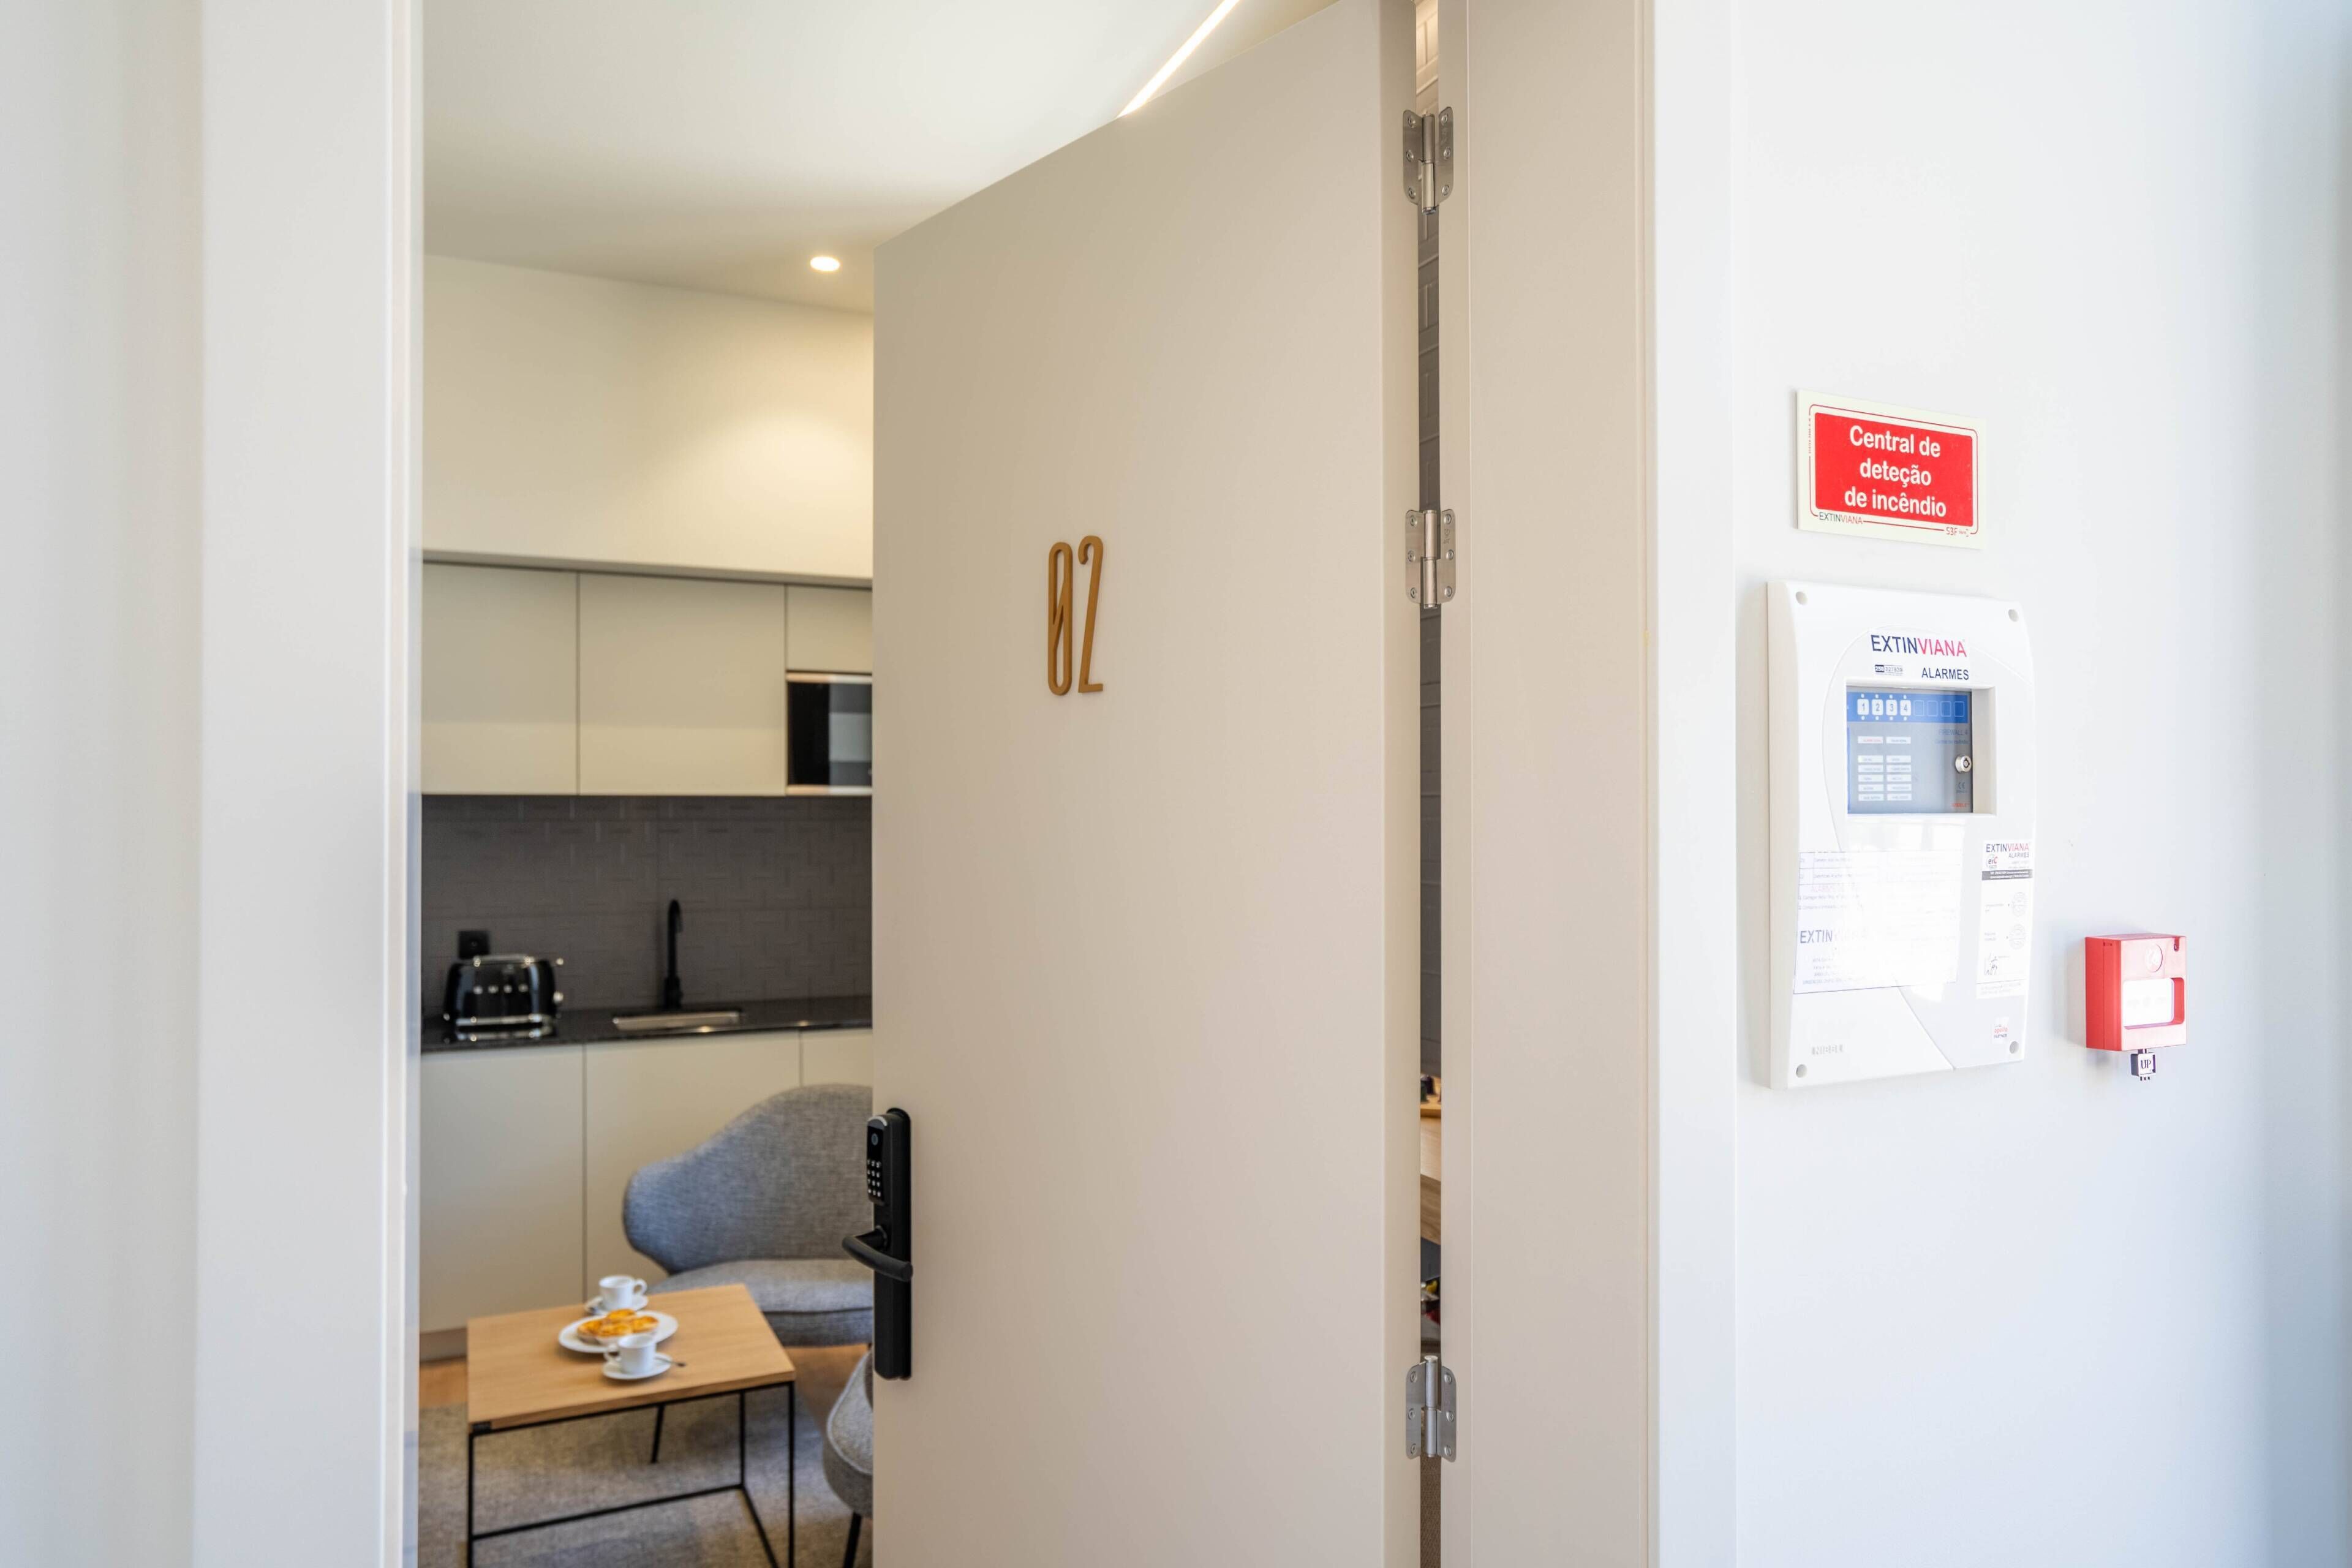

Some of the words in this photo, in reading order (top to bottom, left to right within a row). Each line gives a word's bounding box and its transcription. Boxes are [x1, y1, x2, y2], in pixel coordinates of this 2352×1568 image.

[1849, 425, 1915, 454] Central
[1919, 436, 1941, 458] de
[1860, 458, 1931, 488] deteção
[1844, 486, 1868, 508] de
[1872, 489, 1947, 517] incêndio
[1819, 511, 1863, 525] EXTINVIANA
[1048, 535, 1104, 696] 02
[1871, 635, 1967, 657] EXTINVIANA
[1921, 667, 1969, 680] ALARMES
[1861, 703, 1866, 712] 1
[1875, 703, 1880, 712] 2
[1890, 703, 1894, 712] 3
[1903, 704, 1908, 712] 4
[1986, 843, 2029, 853] EXTINVIANA
